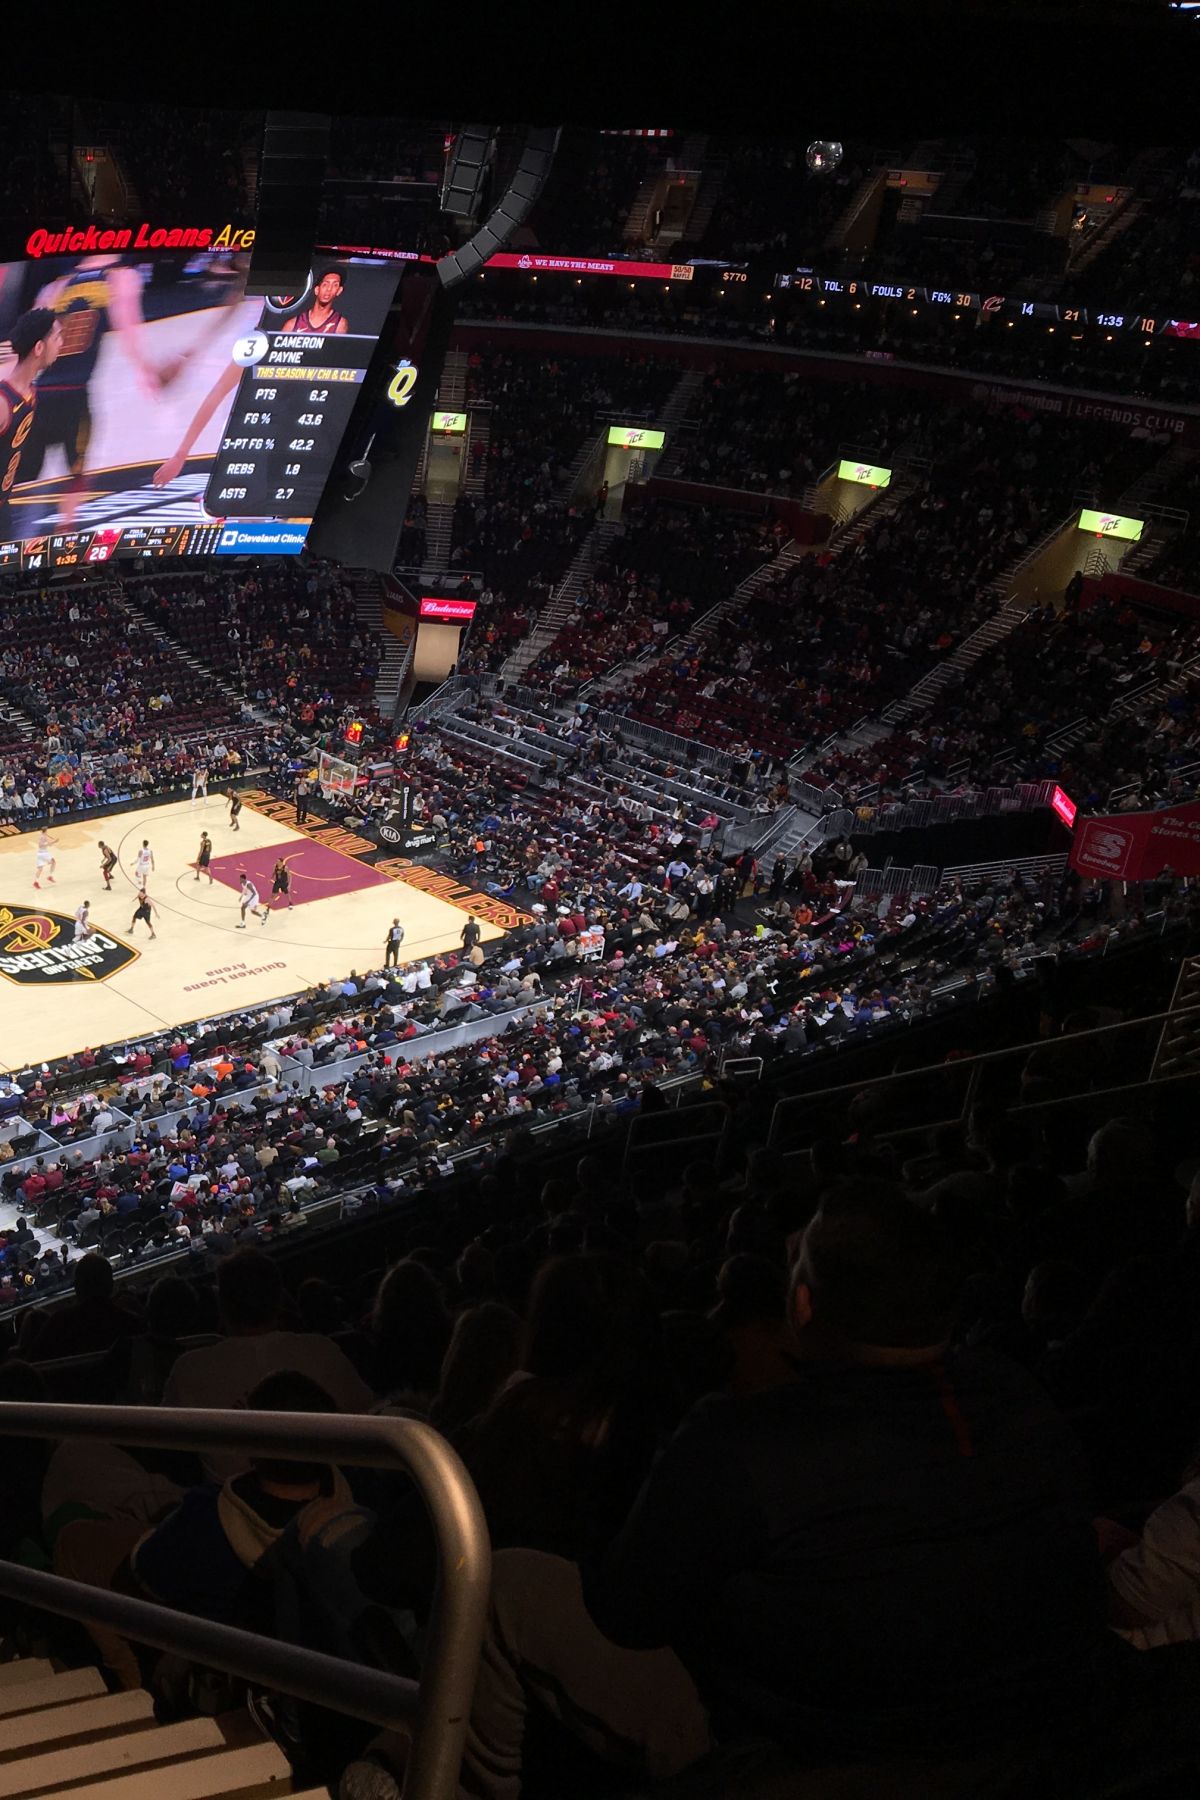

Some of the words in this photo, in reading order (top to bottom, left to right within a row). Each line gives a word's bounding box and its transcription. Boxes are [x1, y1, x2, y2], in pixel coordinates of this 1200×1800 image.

[26, 224, 132, 257] Quicken
[133, 223, 213, 248] Loans
[214, 224, 256, 248] Are
[534, 258, 548, 266] WE
[549, 259, 570, 268] HAVE
[570, 260, 587, 269] THE
[587, 262, 614, 271] MEATS
[673, 265, 692, 273] 50/50
[722, 271, 748, 282] $770
[794, 278, 813, 290] -12
[824, 280, 844, 292] TOL:
[849, 282, 857, 294] 6
[872, 285, 903, 297] FOULS
[907, 288, 916, 300] 2
[931, 291, 951, 303] FG%
[956, 294, 971, 306] 30
[1022, 302, 1034, 315] 14
[1064, 310, 1080, 321] 21
[1096, 314, 1124, 326] 1:35
[1141, 318, 1155, 333] 1Q
[243, 339, 257, 357] 3
[273, 335, 325, 349] CAMERON
[268, 351, 304, 364] PAYNE
[256, 367, 274, 378] THIS
[274, 368, 307, 379] SEASON
[306, 368, 318, 381] W/
[317, 369, 332, 380] CHI
[332, 369, 340, 380] &
[340, 370, 357, 381] CLE
[388, 366, 418, 406] Q
[254, 388, 277, 400] PTS
[309, 389, 329, 402] 6.2
[243, 412, 259, 425] FG
[260, 412, 271, 425] %
[297, 413, 324, 426] 43.6
[443, 415, 459, 428] ICE
[1075, 404, 1143, 426] LEGENDS
[629, 430, 646, 444] ICE
[222, 438, 248, 450] 3-PT
[248, 438, 264, 450] FG
[264, 438, 275, 450] %
[289, 439, 315, 451] 42.2
[226, 463, 255, 475] REBS
[285, 464, 301, 476] 1.8
[857, 467, 873, 481] ICE
[218, 488, 247, 500] ASTS
[275, 488, 295, 500] 2.7
[1101, 518, 1122, 532] ICE
[53, 537, 63, 548] 1Q
[79, 535, 90, 543] 21
[237, 533, 280, 544] Cleveland
[280, 534, 306, 544] Clinic
[56, 554, 78, 566] 1:35
[89, 546, 109, 561] 26
[28, 554, 43, 569] 14
[423, 601, 474, 615] Budweiser
[347, 727, 360, 741] 21
[383, 829, 398, 841] KIA
[1151, 825, 1190, 839] Stores
[420, 835, 436, 844] mart
[374, 857, 534, 929] CAVALIERS
[41, 956, 104, 975] CLEVELAND
[205, 962, 248, 977] Arena
[228, 961, 288, 980] Quicken
[183, 977, 229, 992] Loans
